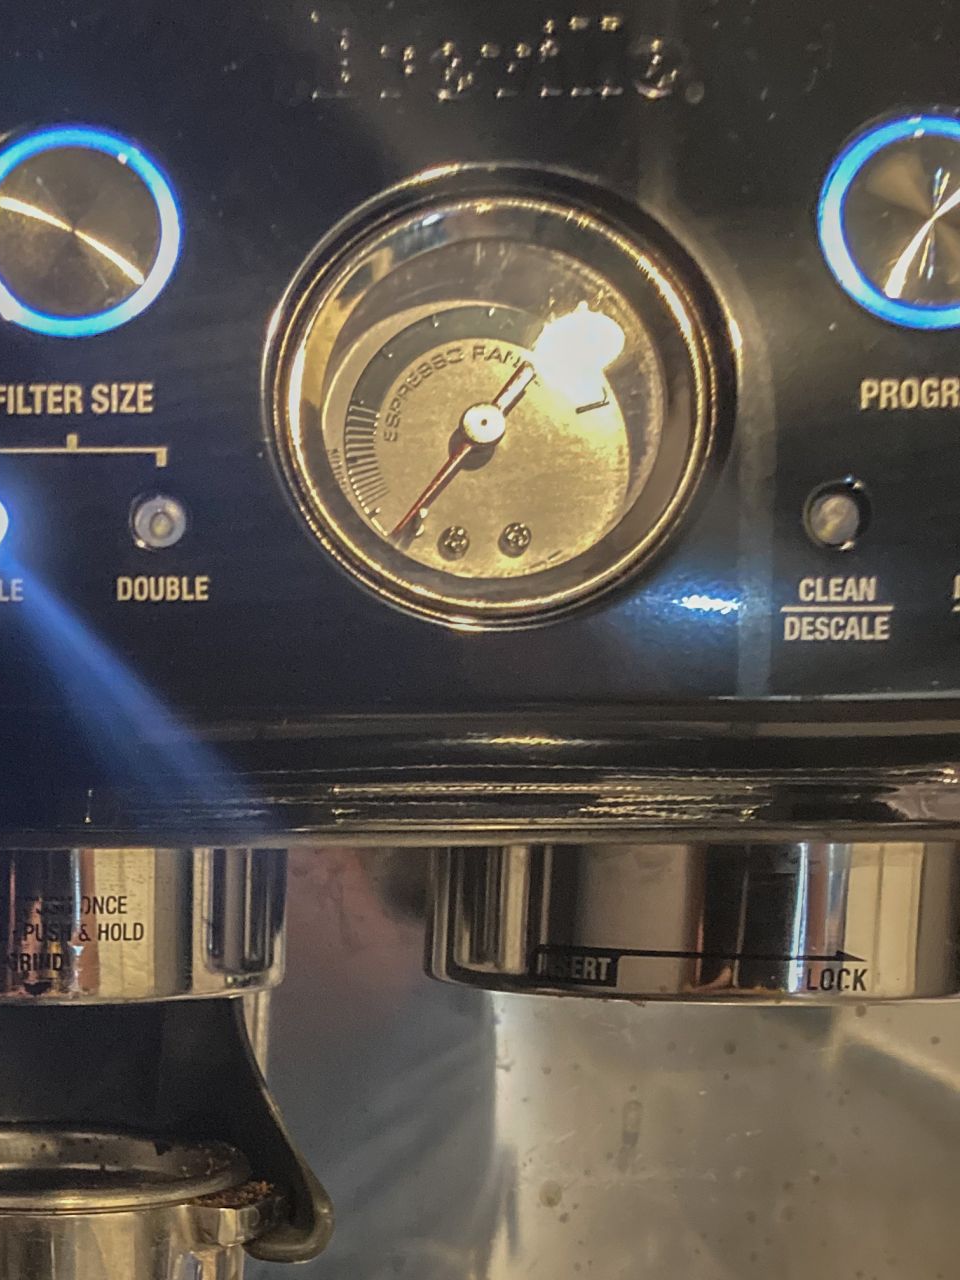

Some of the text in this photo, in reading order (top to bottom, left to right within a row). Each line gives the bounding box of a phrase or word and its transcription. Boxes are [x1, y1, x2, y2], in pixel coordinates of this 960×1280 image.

[91, 382, 154, 414] SIZE
[116, 576, 210, 601] DOUBLE
[799, 576, 877, 602] CLEAN
[783, 614, 890, 641] DESCALE
[78, 924, 92, 942] &
[97, 922, 145, 942] HOLD
[536, 952, 612, 981] IERT
[806, 967, 868, 992] LOCK
